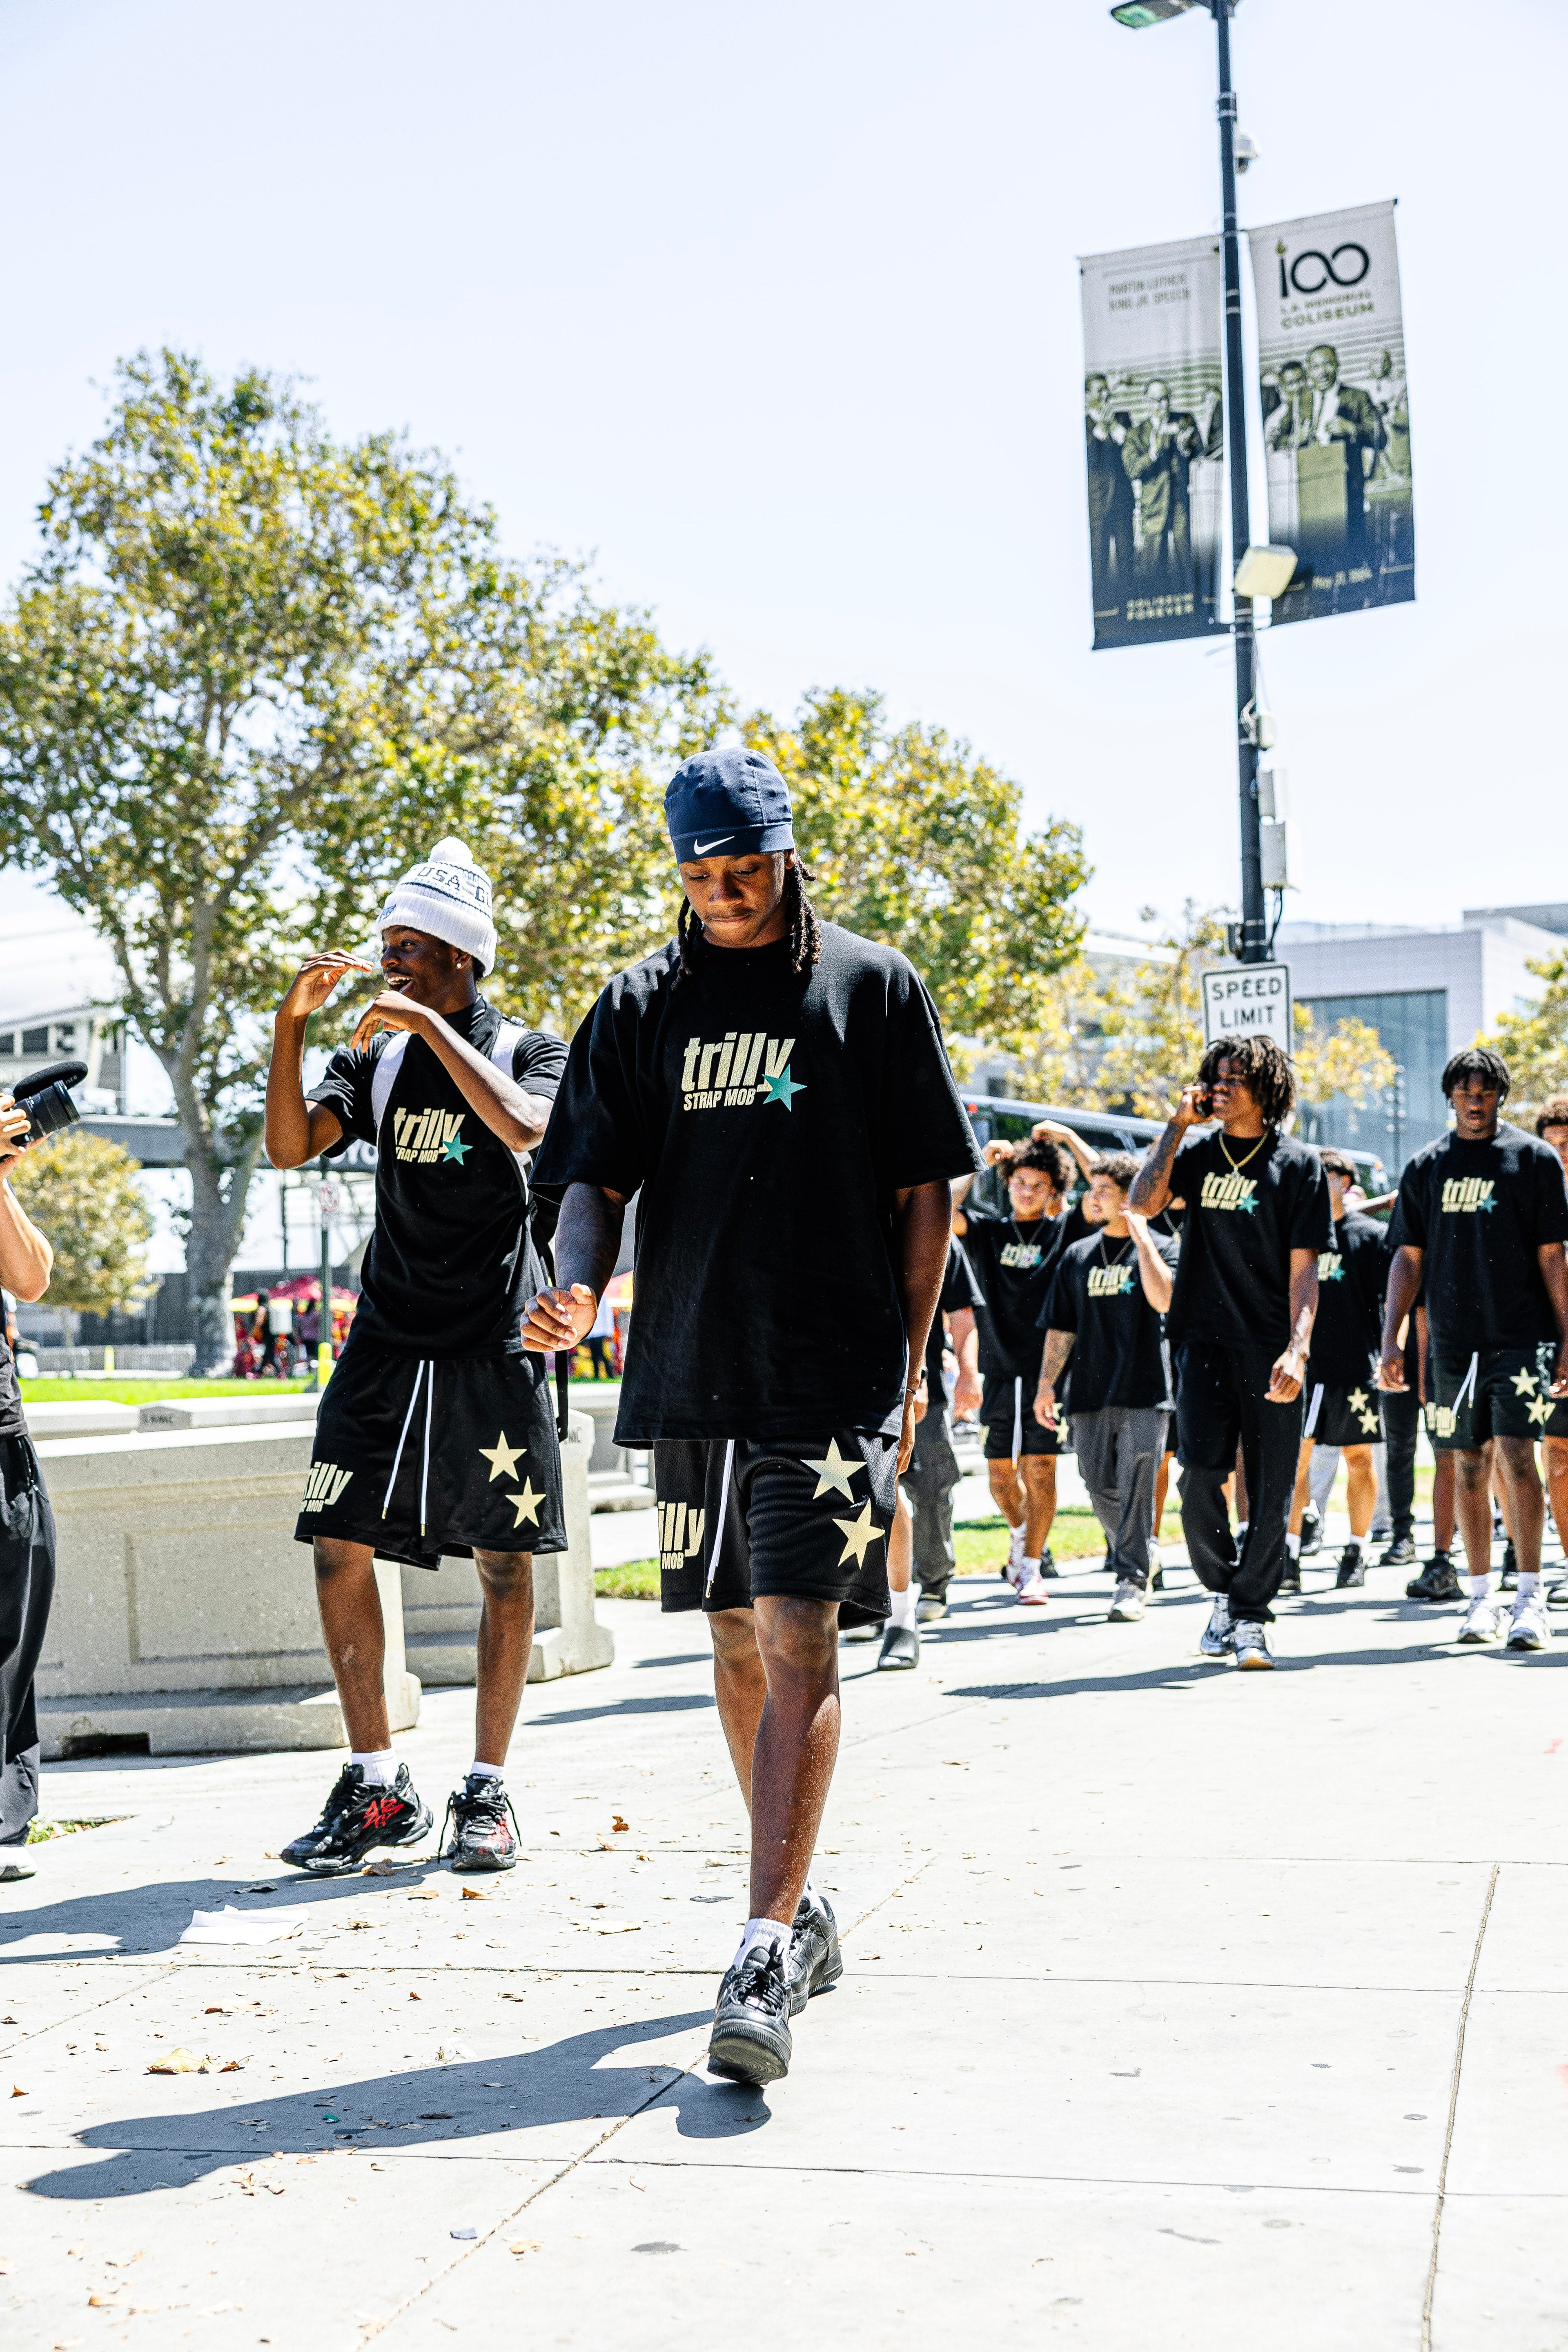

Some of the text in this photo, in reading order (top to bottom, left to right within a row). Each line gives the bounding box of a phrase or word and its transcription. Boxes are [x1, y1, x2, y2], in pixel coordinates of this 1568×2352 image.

[1305, 289, 1371, 308] MEMORIAL
[1281, 302, 1374, 330] COLISEUM
[417, 867, 460, 891] USA
[1212, 977, 1282, 1001] SPEED
[1220, 1004, 1276, 1029] LIMIT
[681, 1032, 796, 1092] trilly
[683, 1088, 757, 1111] STRAP MOB
[394, 1107, 466, 1154] trilly
[417, 1149, 439, 1163] MOB
[1441, 1176, 1495, 1207] trilly
[658, 1501, 705, 1557] illy
[662, 1552, 684, 1570] MOB
